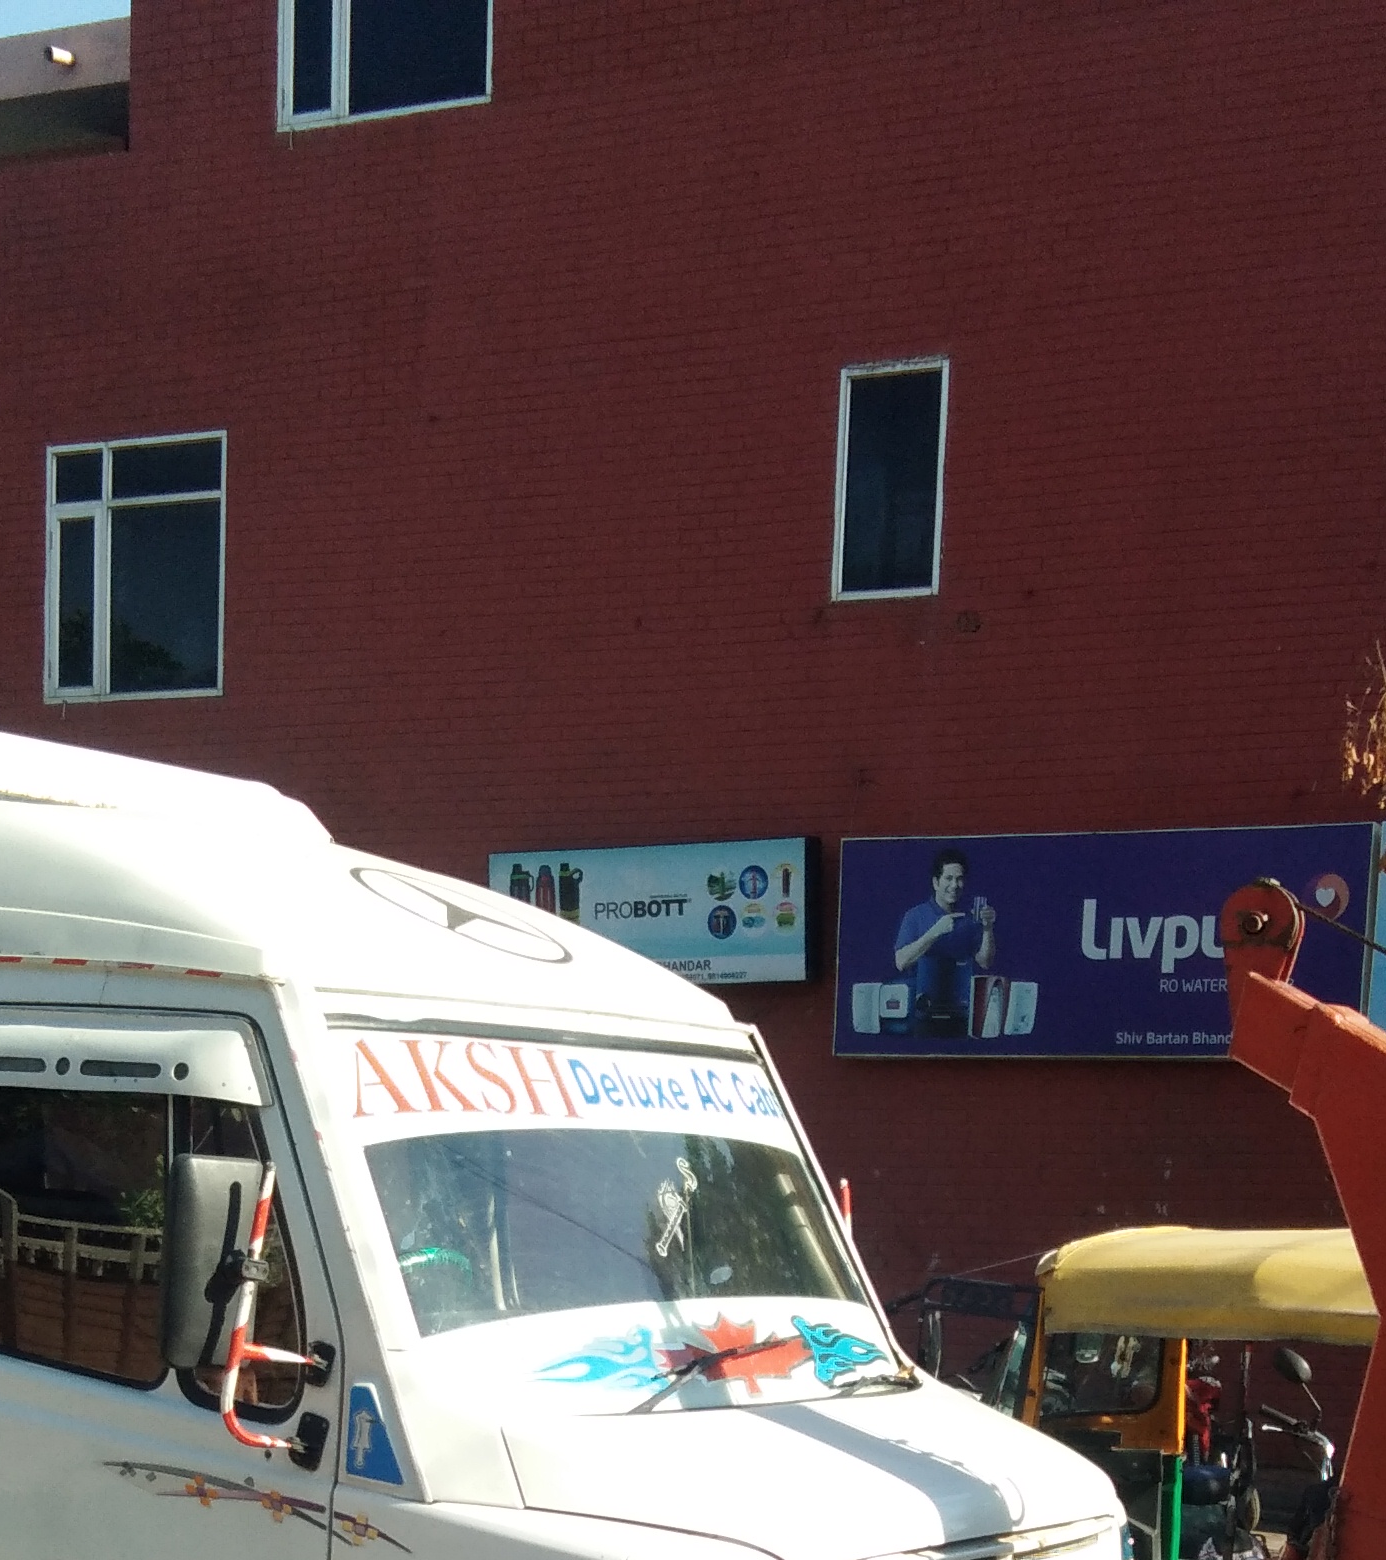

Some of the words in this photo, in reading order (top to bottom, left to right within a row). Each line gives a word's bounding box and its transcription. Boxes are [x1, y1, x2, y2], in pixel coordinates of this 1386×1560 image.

[594, 899, 688, 919] PROBOTT
[1081, 898, 1225, 974] Livpu
[657, 959, 712, 972] HANDAR
[1160, 978, 1178, 993] RO
[1182, 978, 1228, 993] WATER
[1115, 1031, 1143, 1046] Shiv
[1146, 1031, 1189, 1046] Bartan
[1192, 1031, 1233, 1045] Bhand
[353, 1038, 584, 1119] AKSH
[567, 1058, 690, 1111] Deluxe
[690, 1068, 734, 1113] AC
